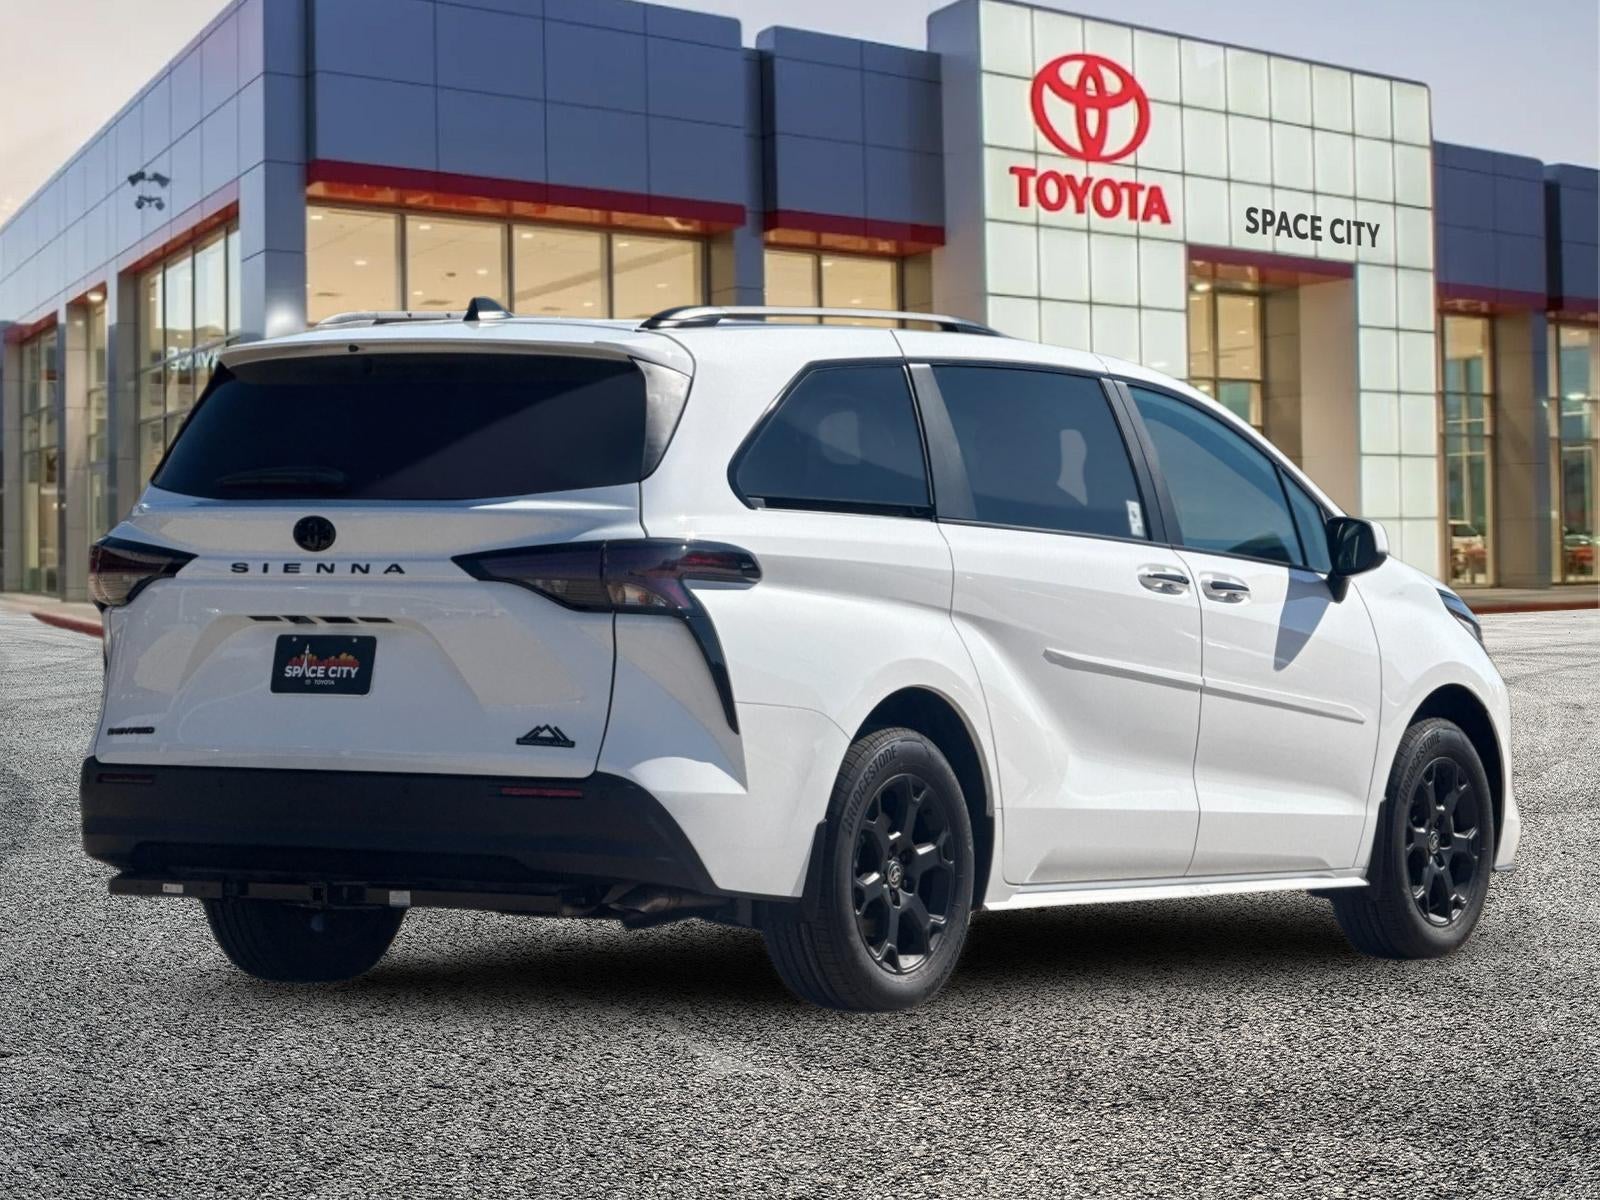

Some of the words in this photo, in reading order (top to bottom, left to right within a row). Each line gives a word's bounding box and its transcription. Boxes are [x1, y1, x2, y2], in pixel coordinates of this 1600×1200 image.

[1009, 166, 1171, 225] TOYOTA
[1245, 206, 1323, 242] SPACE
[1329, 218, 1381, 248] CITY
[231, 562, 406, 574] SIENNA
[284, 665, 326, 678] SPACE
[328, 666, 360, 679] CITY
